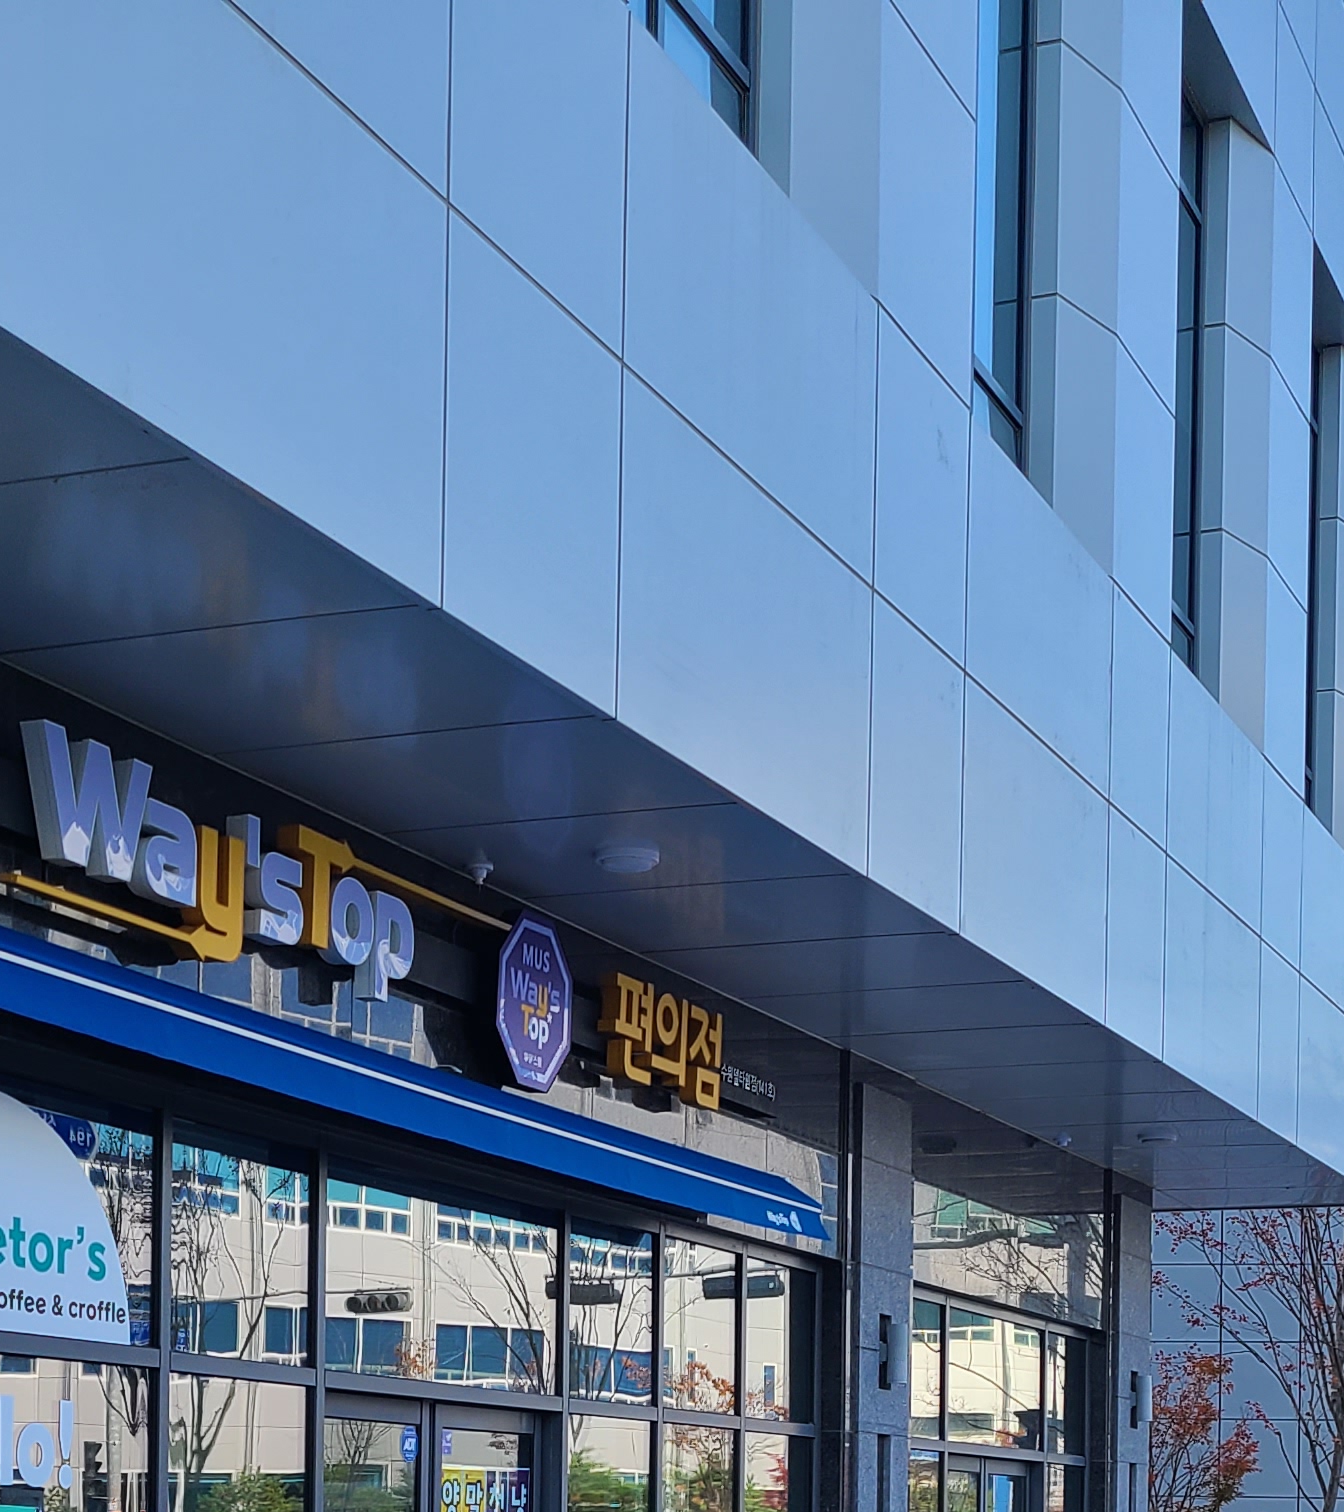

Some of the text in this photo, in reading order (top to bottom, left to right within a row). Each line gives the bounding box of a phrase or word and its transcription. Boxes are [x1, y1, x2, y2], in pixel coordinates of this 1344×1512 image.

[523, 943, 550, 972] MUS
[510, 967, 560, 1019] Way's
[520, 1004, 549, 1050] Top
[607, 972, 724, 1110] 편의점
[51, 1295, 64, 1317] &
[69, 1300, 127, 1325] croffle
